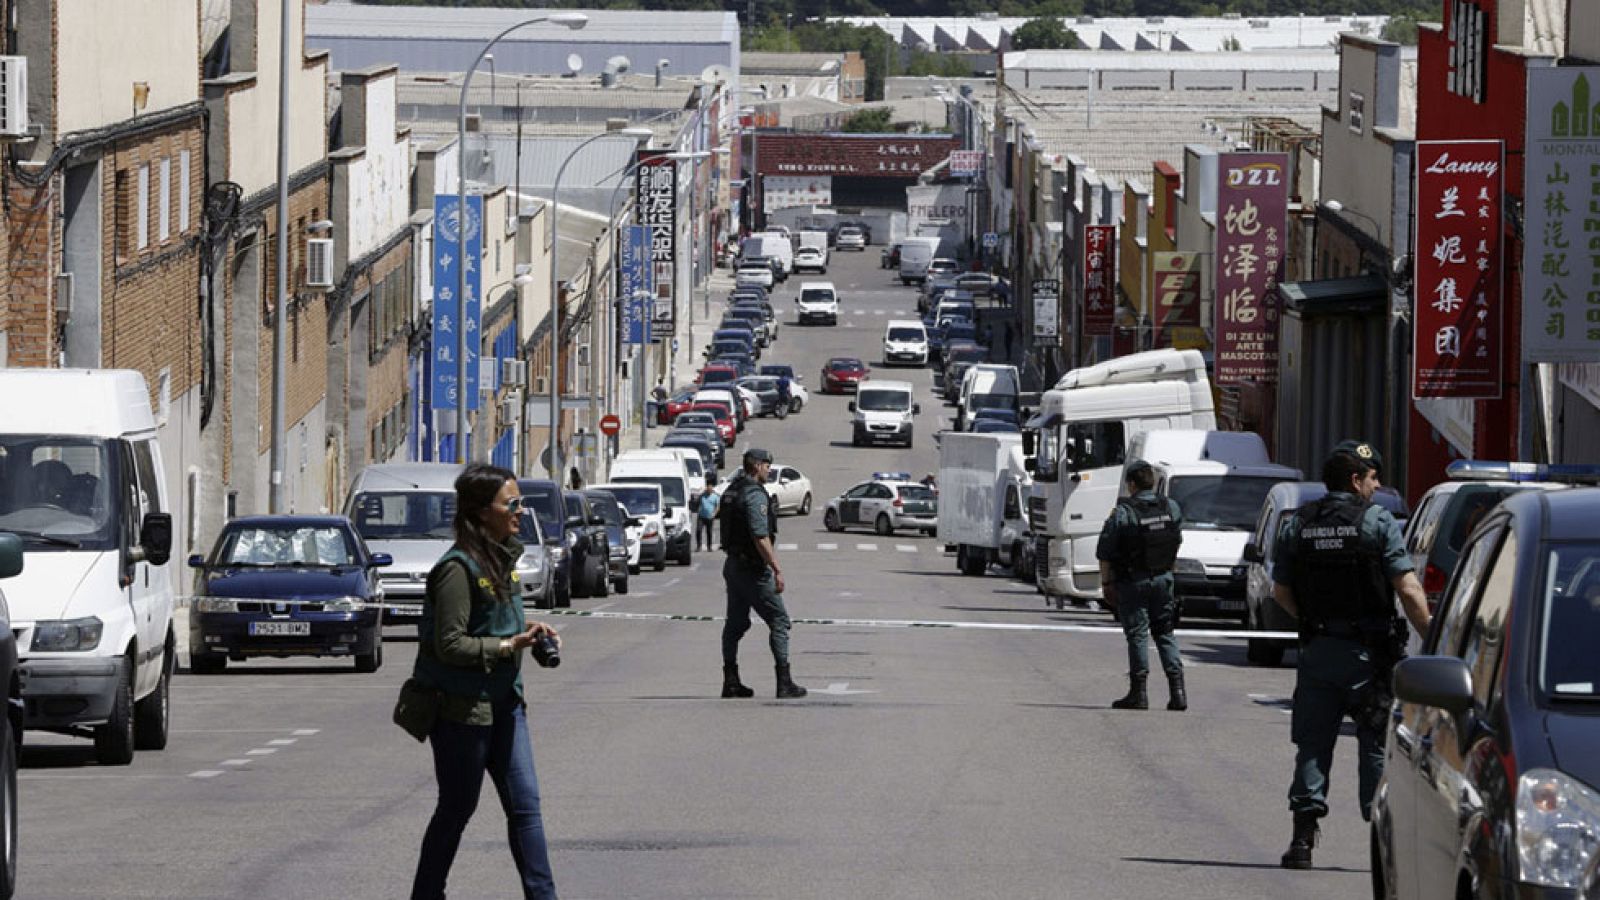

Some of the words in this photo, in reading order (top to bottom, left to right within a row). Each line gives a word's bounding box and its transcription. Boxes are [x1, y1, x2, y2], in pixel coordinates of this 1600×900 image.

[1228, 168, 1280, 186] DZL
[1425, 151, 1499, 178] Lanny
[1223, 198, 1262, 323] 地泽临
[1541, 161, 1571, 339] 山林汽配公司
[1431, 186, 1467, 358] 兰妮集团
[1241, 332, 1254, 341] ZE
[1337, 525, 1359, 536] CIVIL
